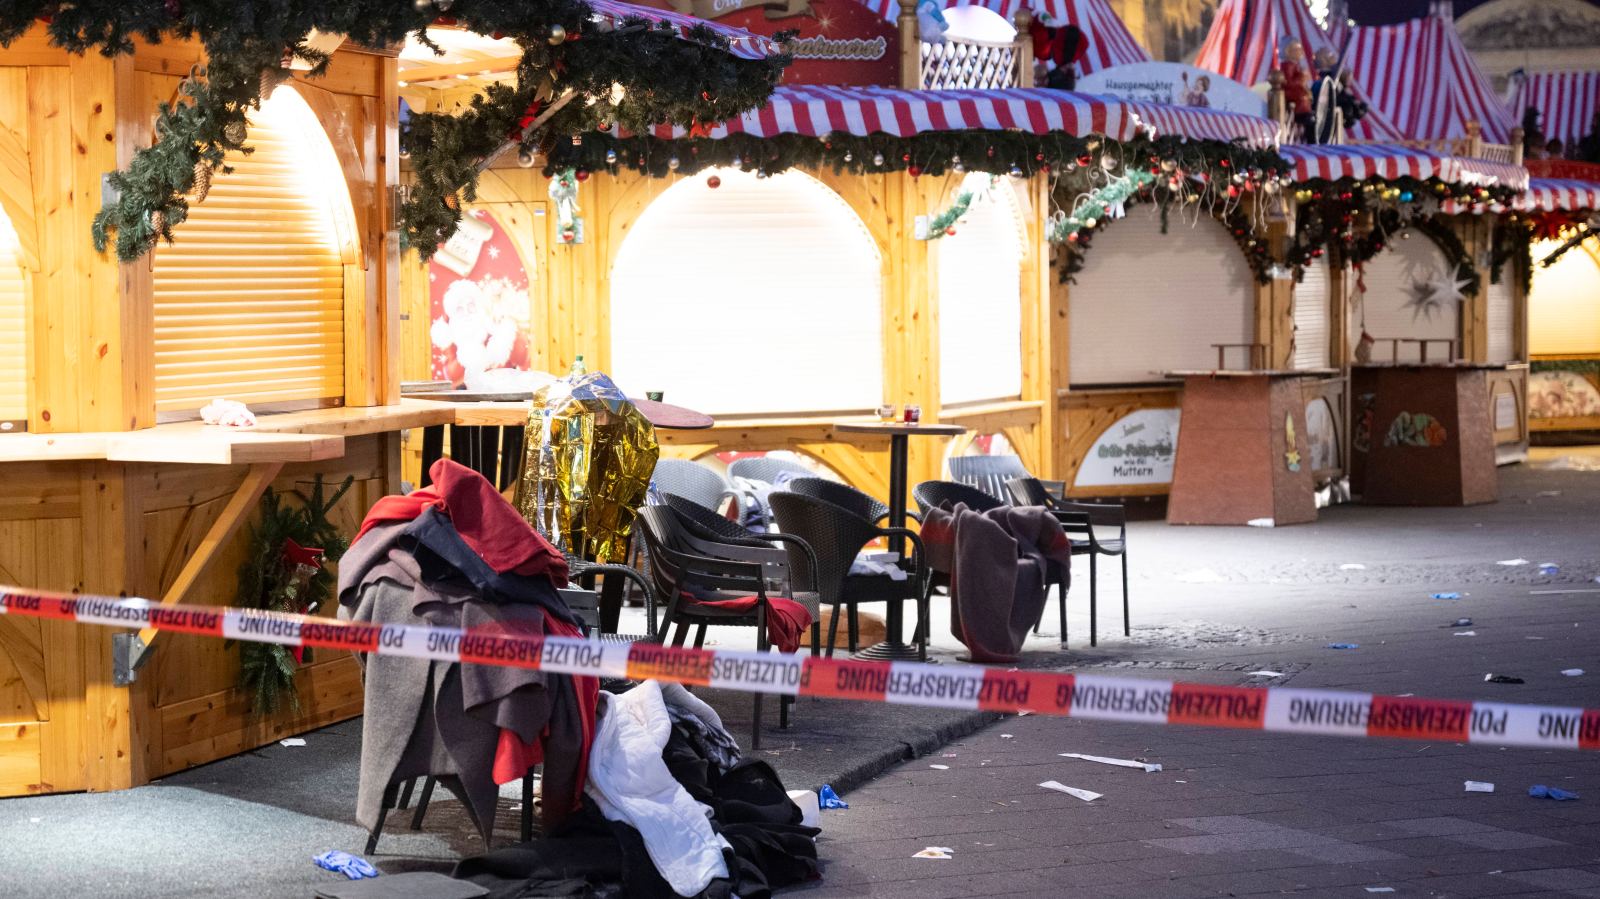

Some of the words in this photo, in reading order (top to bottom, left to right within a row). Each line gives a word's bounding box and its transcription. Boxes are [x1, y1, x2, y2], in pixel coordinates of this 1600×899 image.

[787, 35, 887, 60] ratwurst
[1113, 466, 1154, 477] Muttern
[427, 631, 603, 668] POLIZEIABSPERRUNG
[628, 648, 811, 687] POLIZEIABSPERRUNG
[836, 667, 1030, 705] POLIZEIABSPERRUNG
[1056, 682, 1260, 720] POLIZEIABSPERRUNG
[1289, 697, 1508, 735] POLIZEIABSPERRUNG
